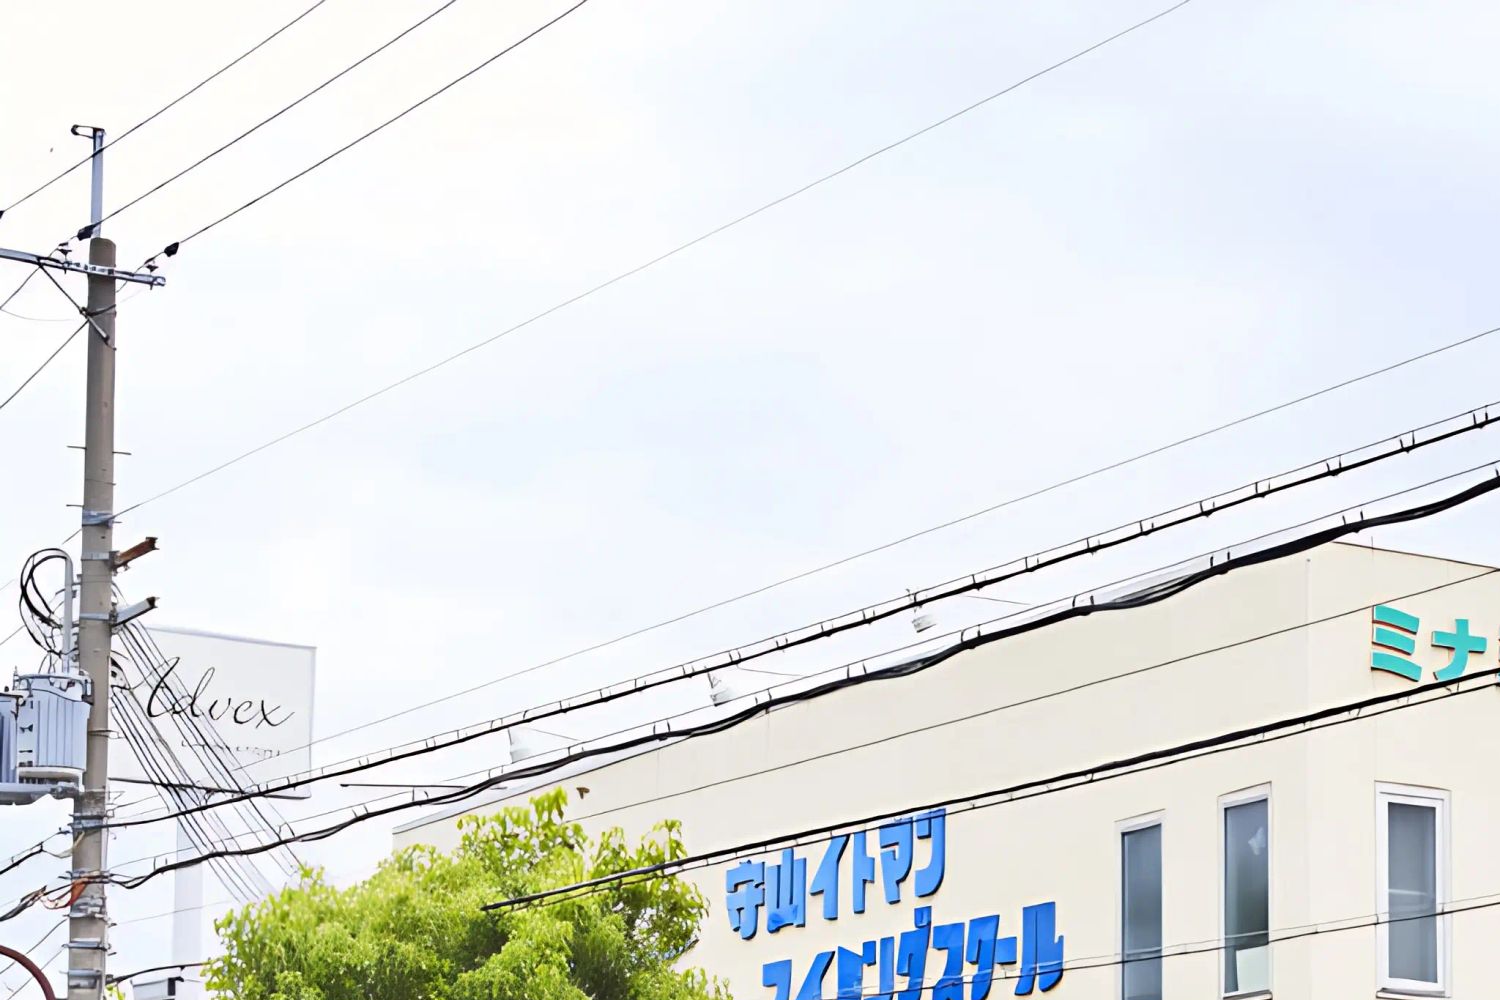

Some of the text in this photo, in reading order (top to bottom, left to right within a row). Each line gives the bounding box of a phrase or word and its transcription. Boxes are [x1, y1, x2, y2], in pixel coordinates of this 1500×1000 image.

[725, 808, 947, 941] 守山イトマン
